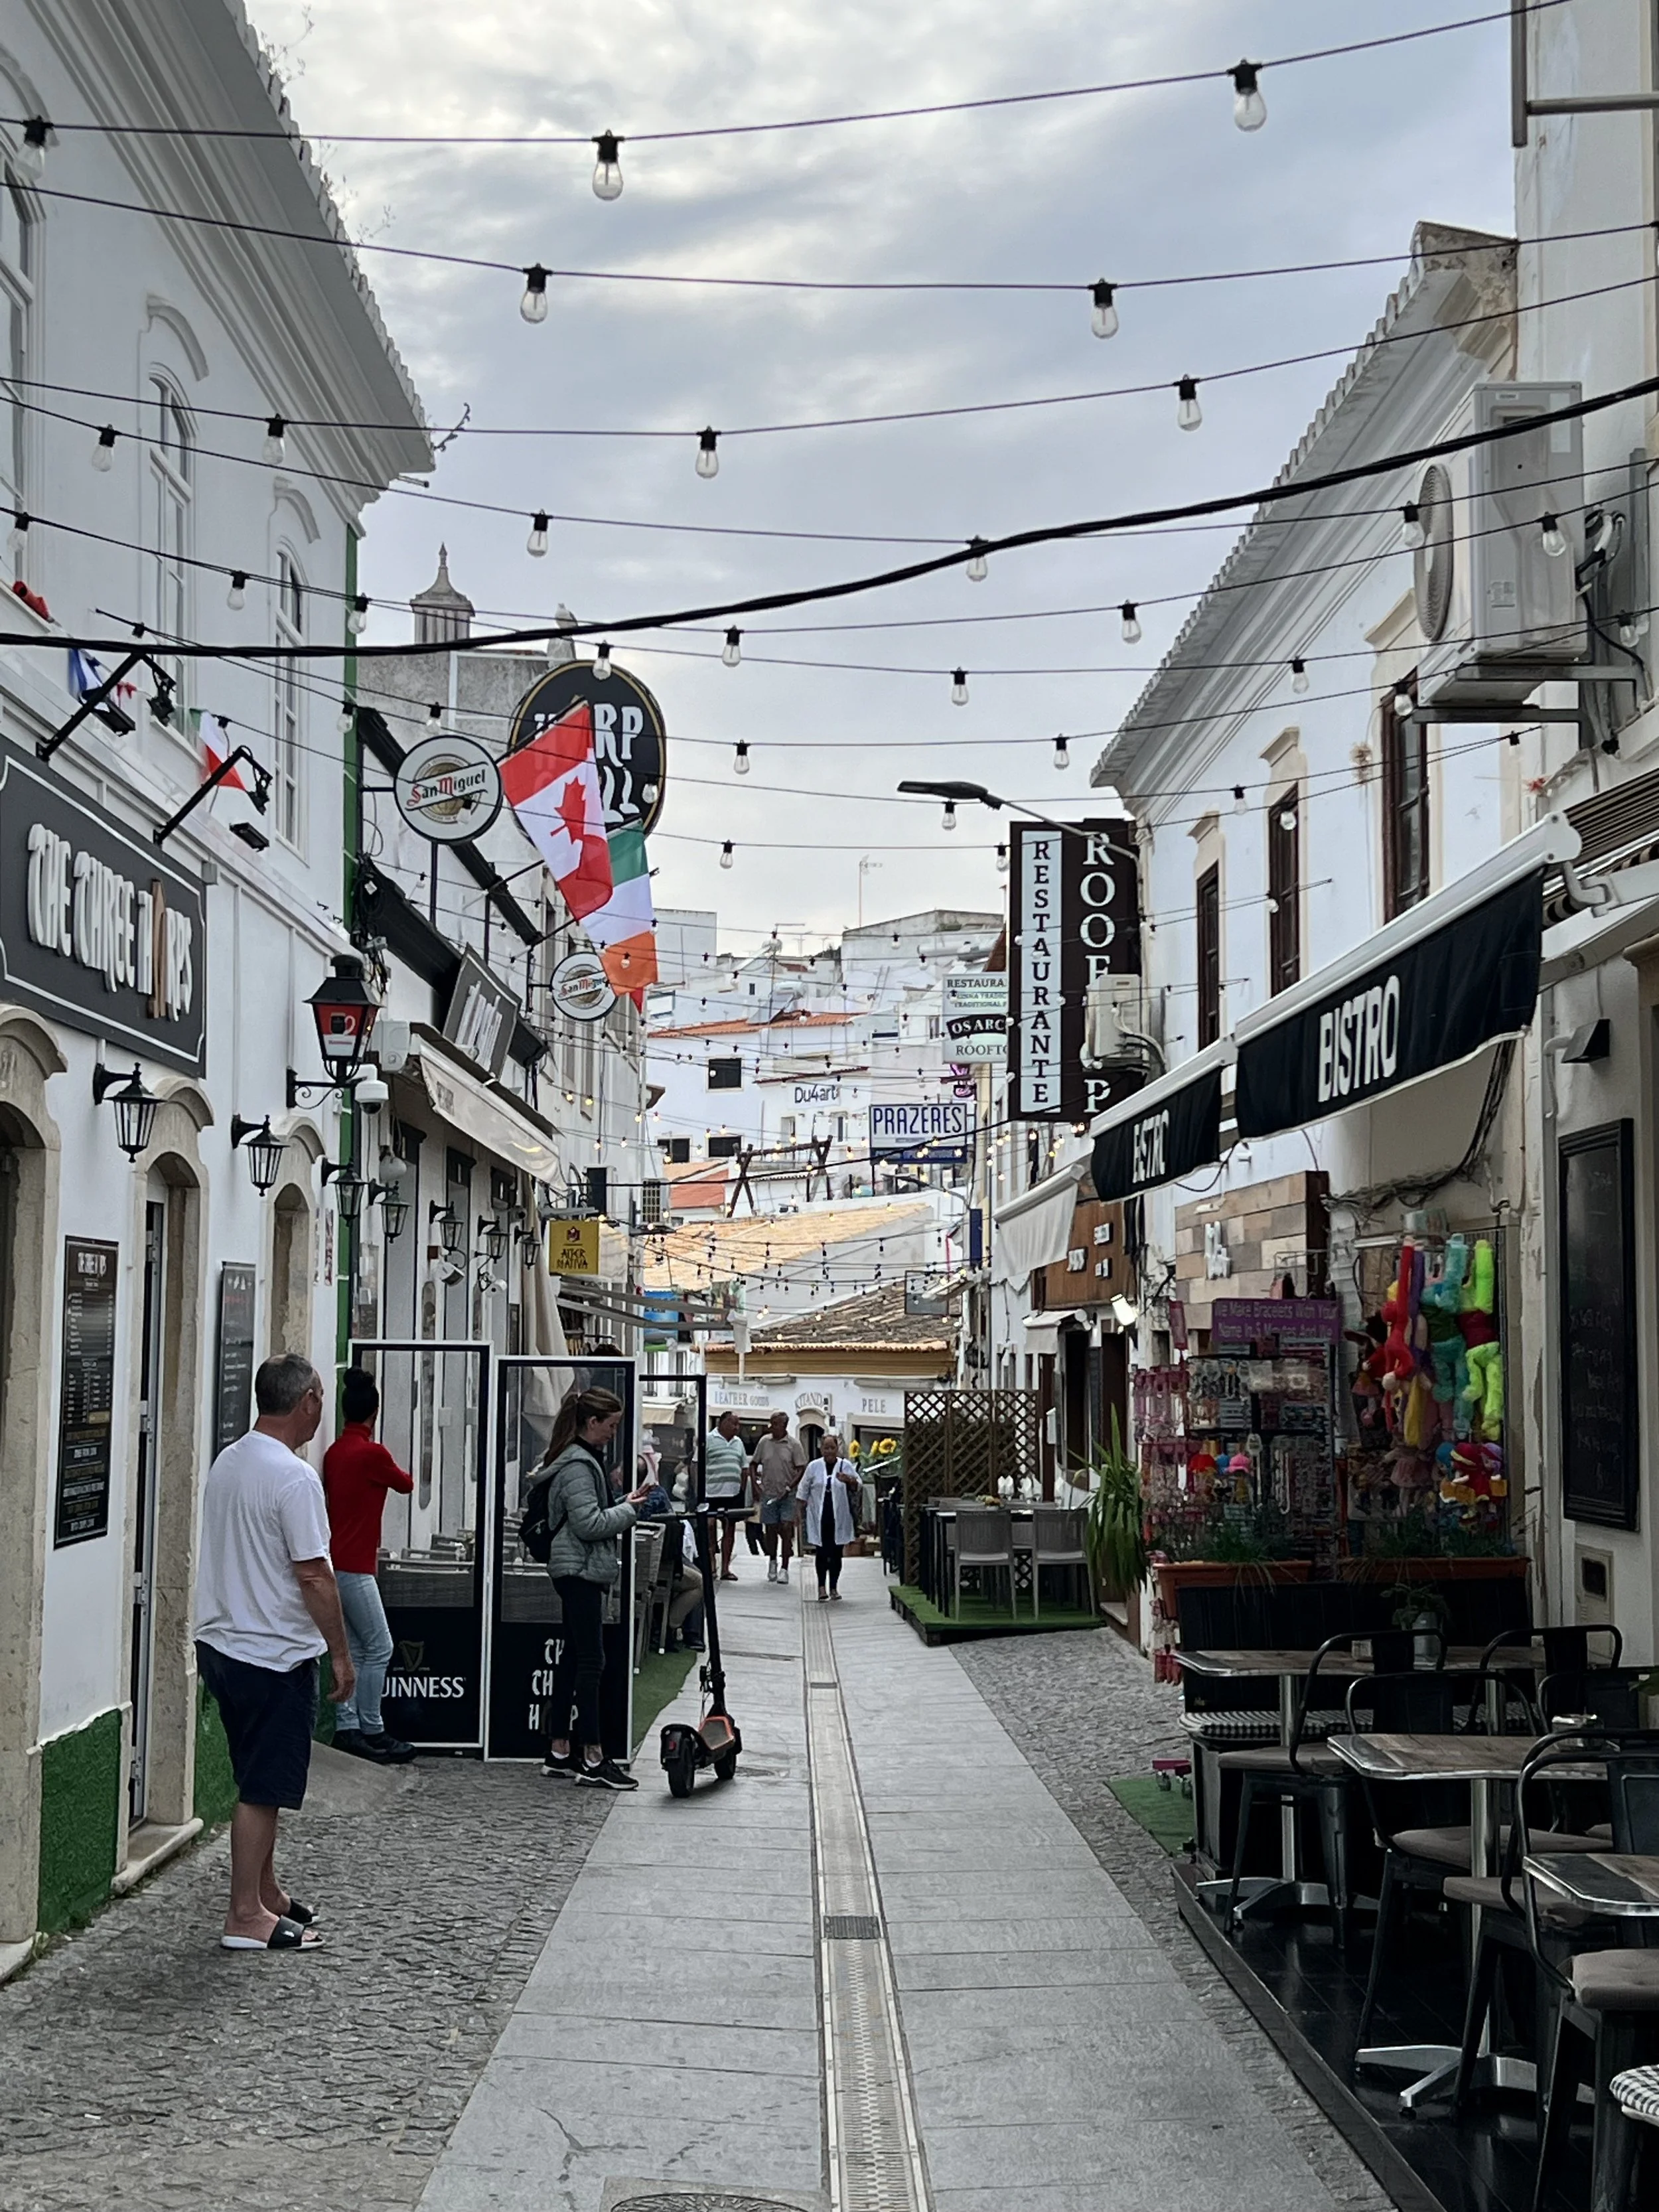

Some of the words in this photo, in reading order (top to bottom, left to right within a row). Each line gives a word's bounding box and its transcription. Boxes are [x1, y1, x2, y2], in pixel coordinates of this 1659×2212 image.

[407, 784, 437, 807] San
[436, 769, 486, 796] Miguel
[28, 824, 71, 957] THE
[73, 851, 135, 993] THREE
[1031, 841, 1051, 1103] RESTAURANTE
[1079, 832, 1116, 1114] ROOFP
[951, 1020, 972, 1034] OS
[1318, 975, 1400, 1102] BISTRO
[873, 1106, 962, 1135] PRAZERES
[1254, 1301, 1293, 1319] Bracelets
[715, 1390, 748, 1406] LEATHER
[862, 1398, 886, 1414] PELE
[381, 1676, 465, 1698] UINNESS
